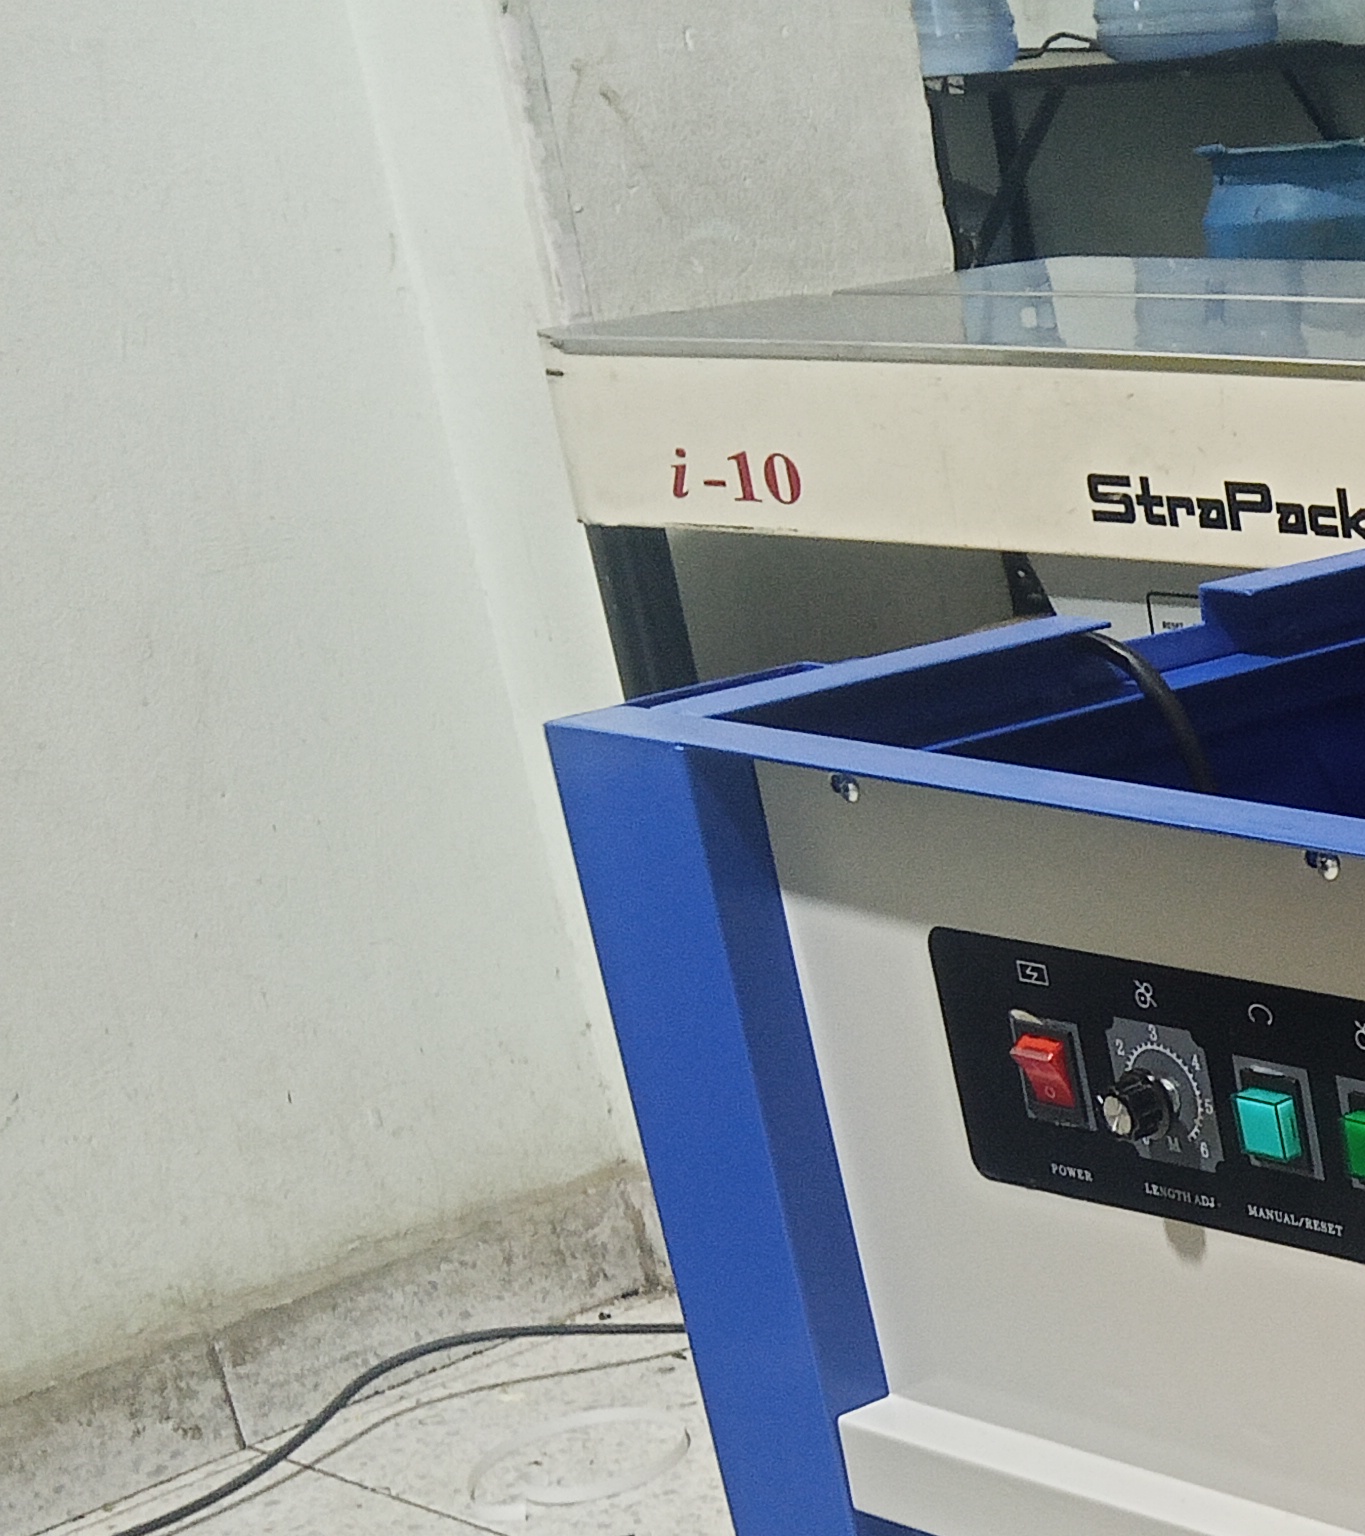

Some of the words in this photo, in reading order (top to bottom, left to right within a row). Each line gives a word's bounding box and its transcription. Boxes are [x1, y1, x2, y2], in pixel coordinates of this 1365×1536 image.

[1148, 1024, 1158, 1041] 3
[1115, 1038, 1125, 1056] 2
[1191, 1054, 1201, 1071] 4
[1204, 1099, 1214, 1114] 5
[1200, 1141, 1209, 1158] 6
[1051, 1163, 1094, 1182] POWER
[1144, 1182, 1191, 1203] LENGTH
[1247, 1204, 1344, 1238] MANUAL/RESET
